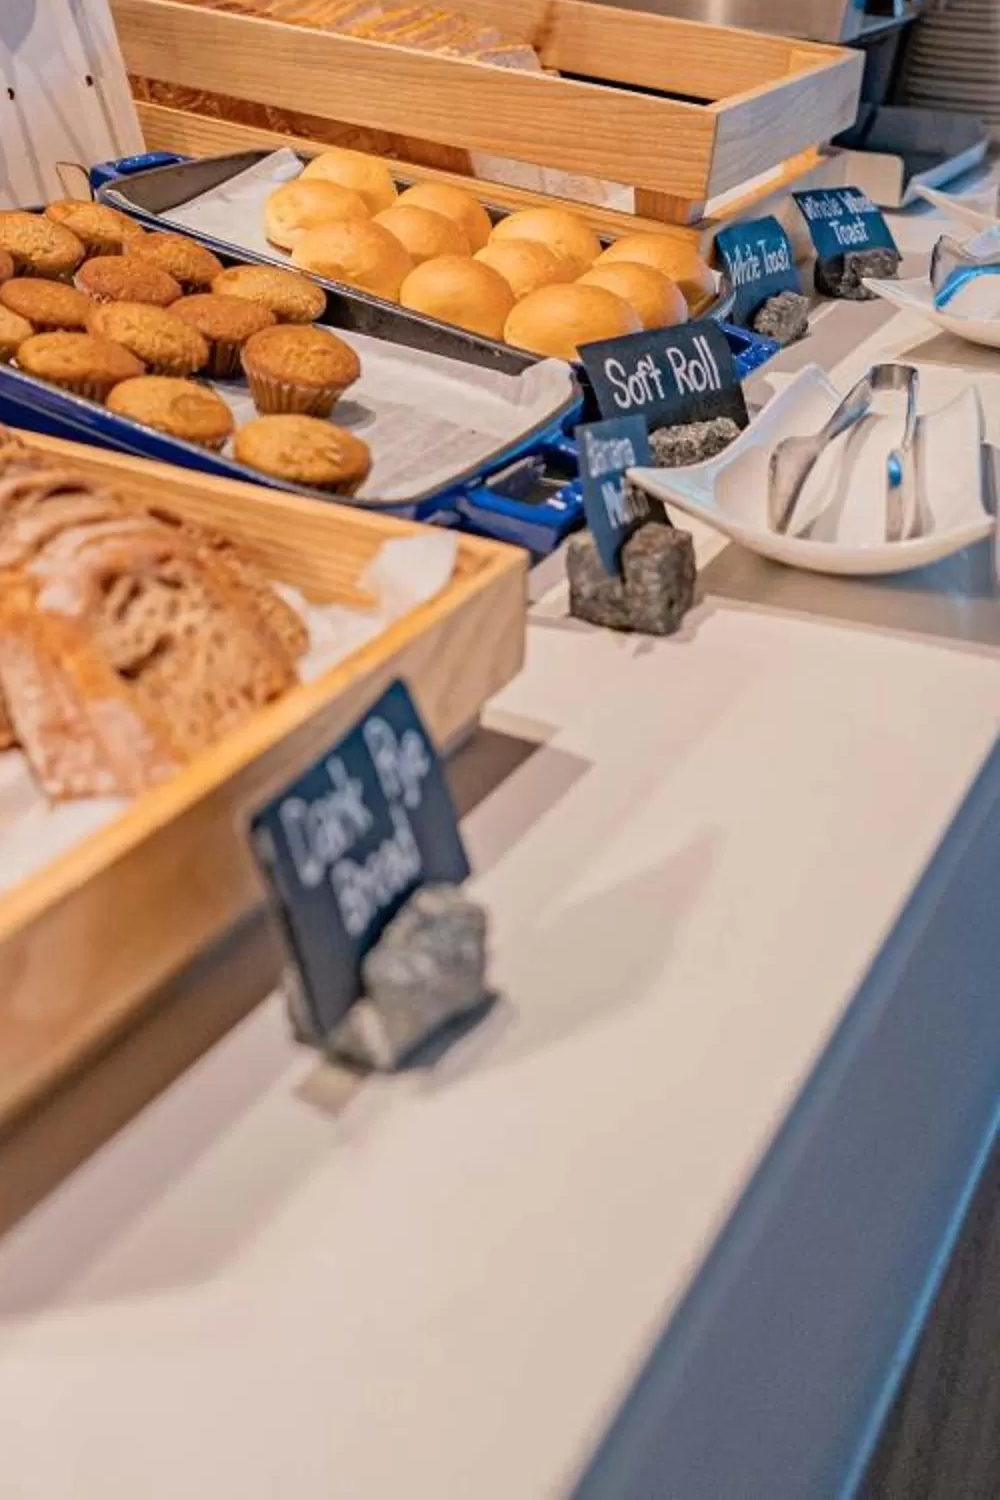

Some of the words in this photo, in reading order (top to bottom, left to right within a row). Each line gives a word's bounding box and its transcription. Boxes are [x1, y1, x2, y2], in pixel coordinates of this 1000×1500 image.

[828, 215, 869, 245] Toast
[723, 243, 761, 287] White
[756, 235, 791, 277] Toast
[604, 353, 665, 410] Soft
[665, 334, 722, 396] Roll
